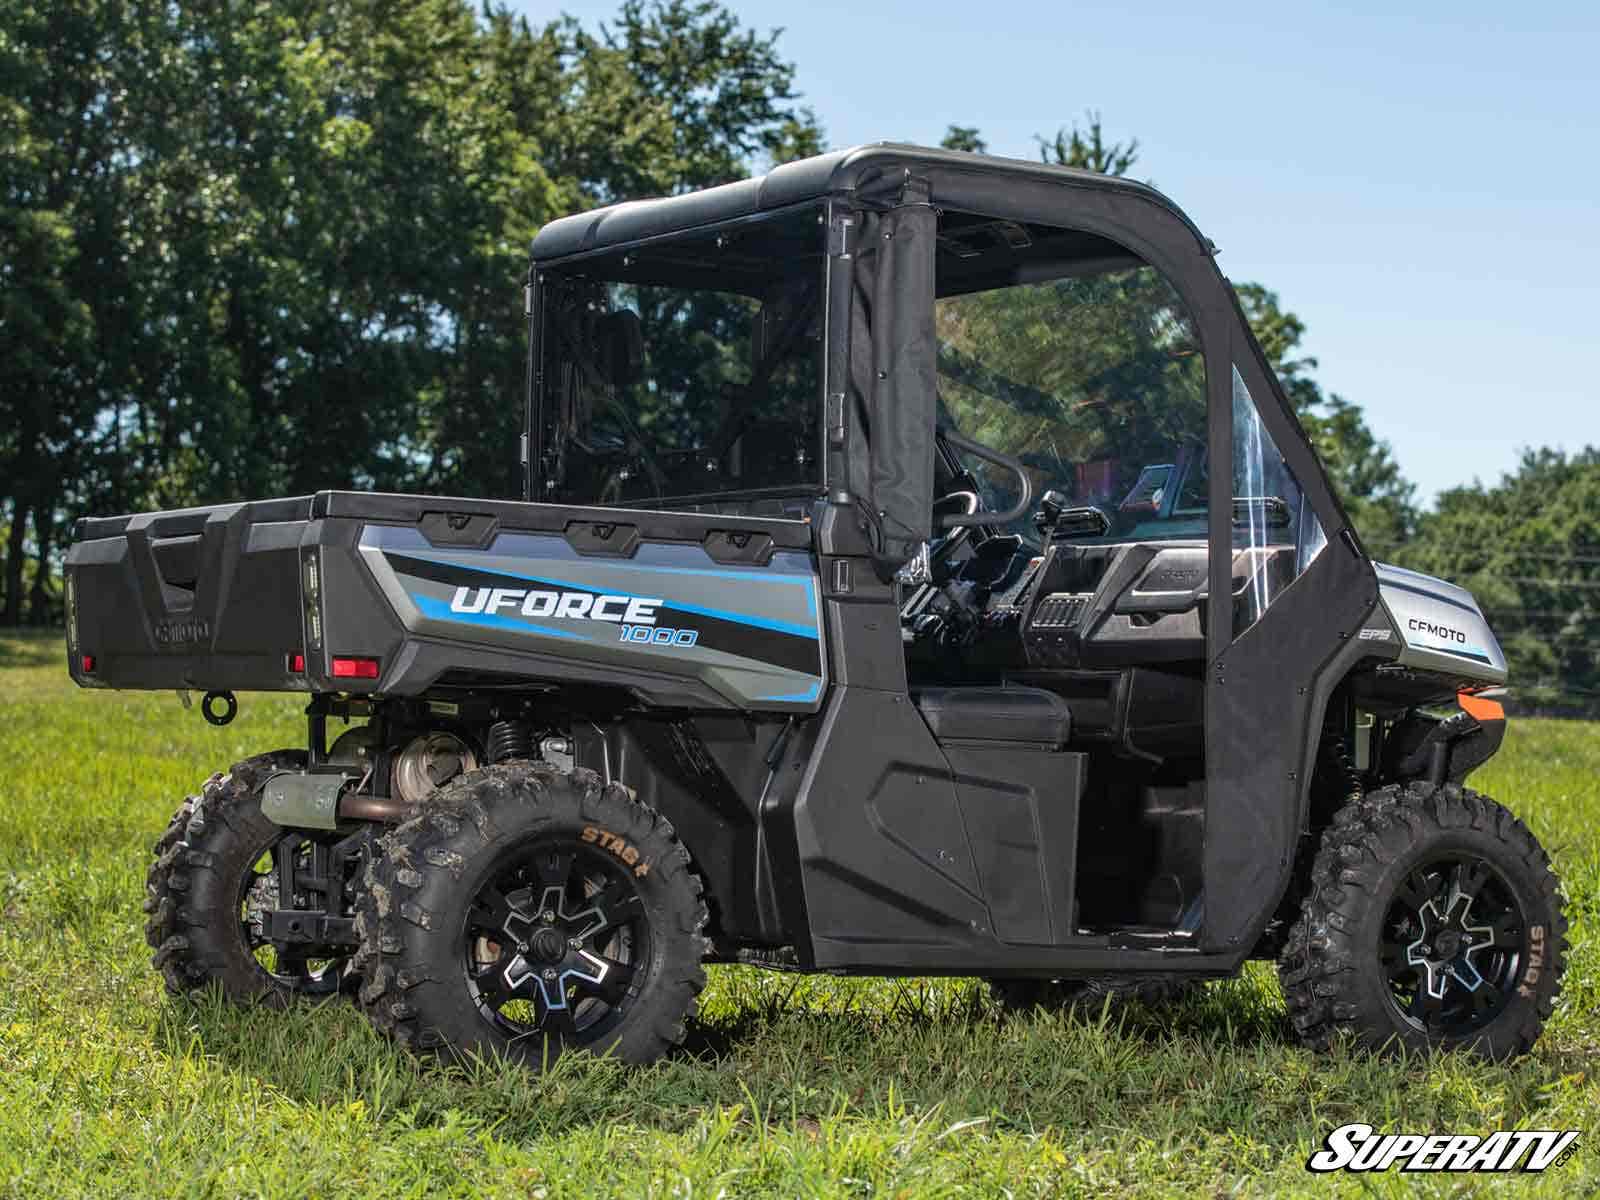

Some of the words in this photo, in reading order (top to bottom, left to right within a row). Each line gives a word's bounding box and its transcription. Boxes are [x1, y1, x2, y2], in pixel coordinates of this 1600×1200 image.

[450, 586, 664, 625] UFORCE
[619, 623, 698, 647] 1000
[1408, 618, 1466, 644] CFMOTO
